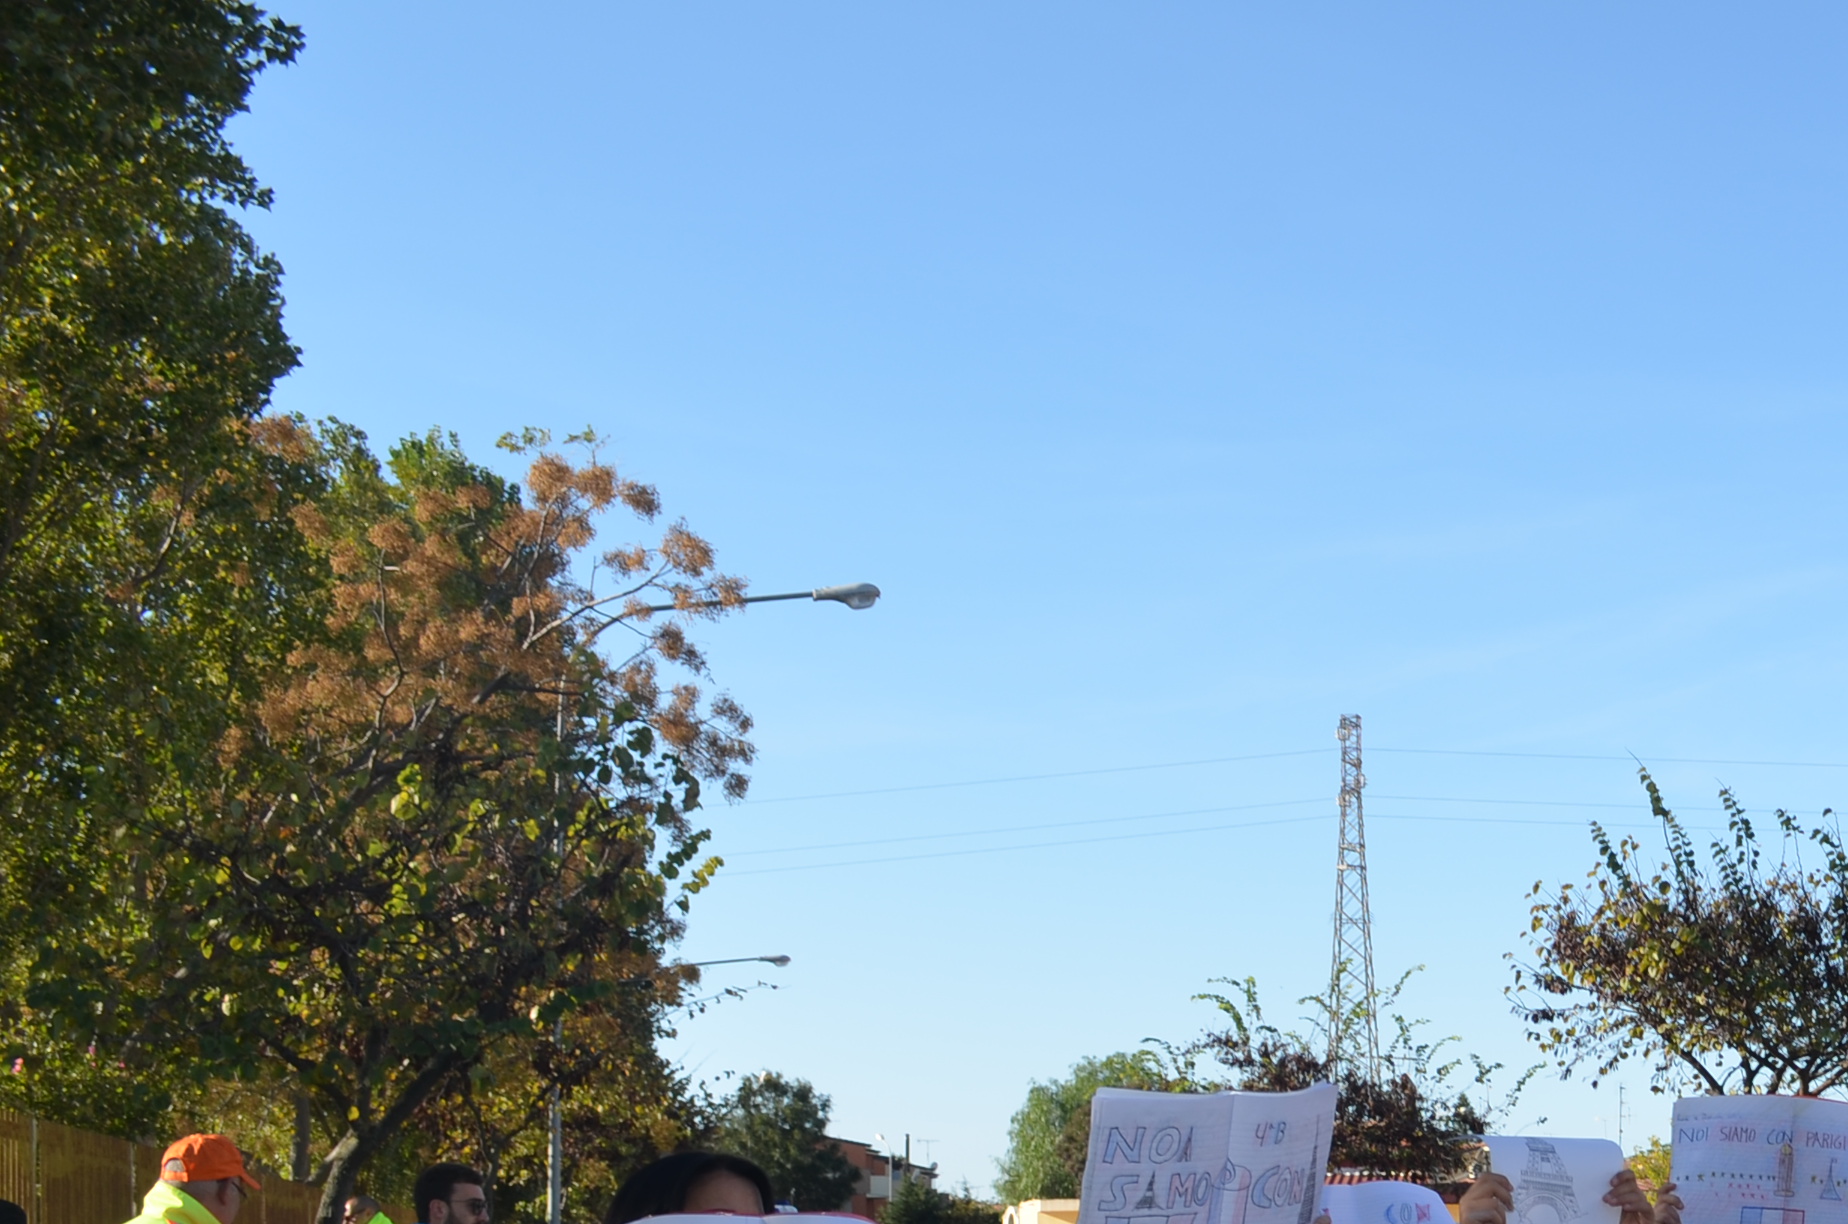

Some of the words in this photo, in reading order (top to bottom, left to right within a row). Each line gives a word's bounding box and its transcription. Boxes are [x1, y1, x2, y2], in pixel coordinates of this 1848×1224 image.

[1679, 1127, 1709, 1144] NOI
[1719, 1127, 1756, 1143] SIAMO
[1766, 1129, 1794, 1145] CON
[1805, 1131, 1846, 1150] PARIGI
[1251, 1164, 1305, 1209] CON
